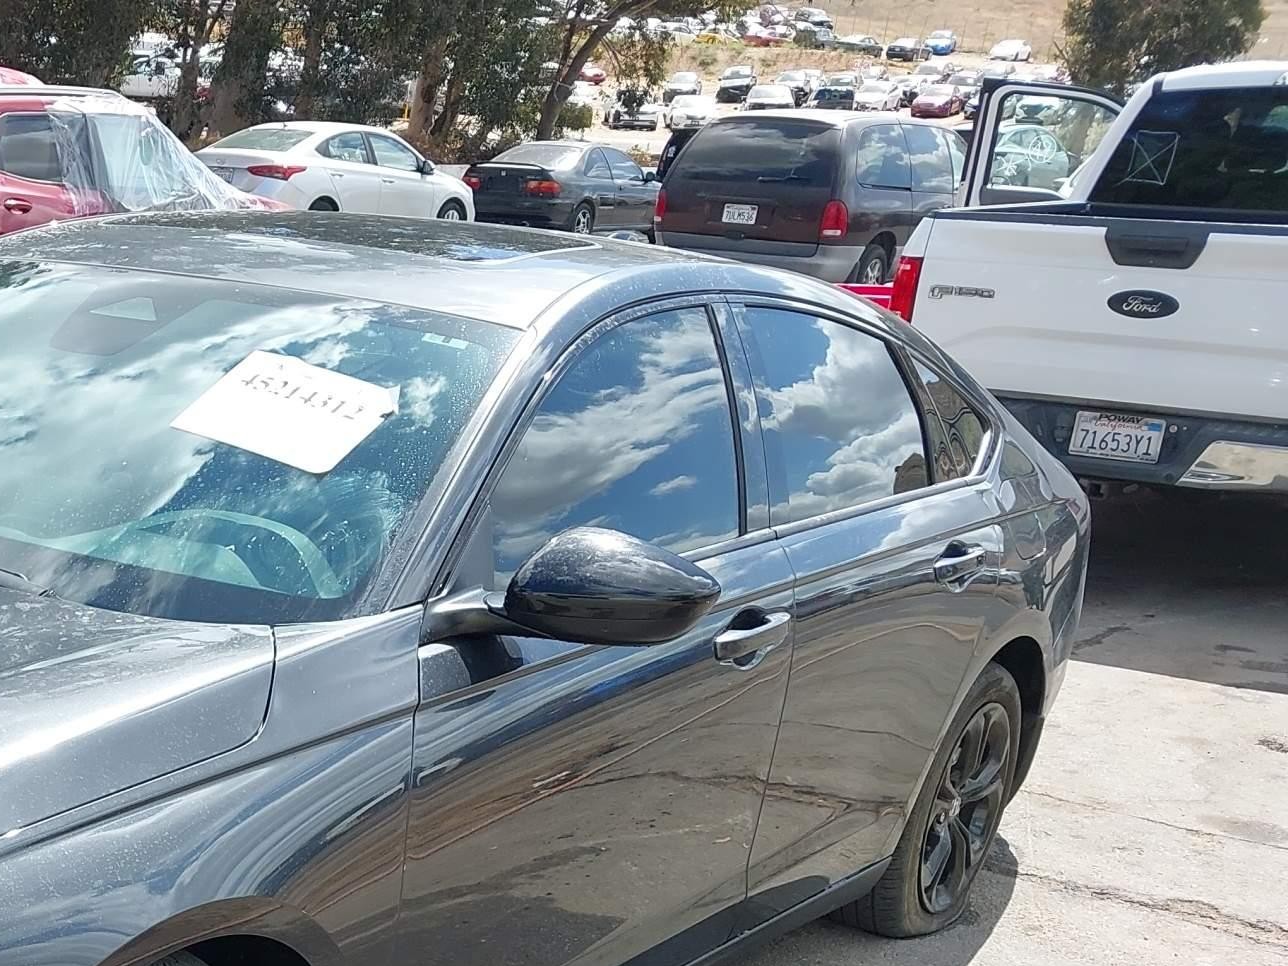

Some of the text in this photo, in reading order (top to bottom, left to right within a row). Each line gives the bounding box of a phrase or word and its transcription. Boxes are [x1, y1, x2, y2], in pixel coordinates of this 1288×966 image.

[1122, 295, 1162, 313] Ford
[1098, 413, 1145, 424] POWAY
[1079, 428, 1153, 456] 71653Y1
